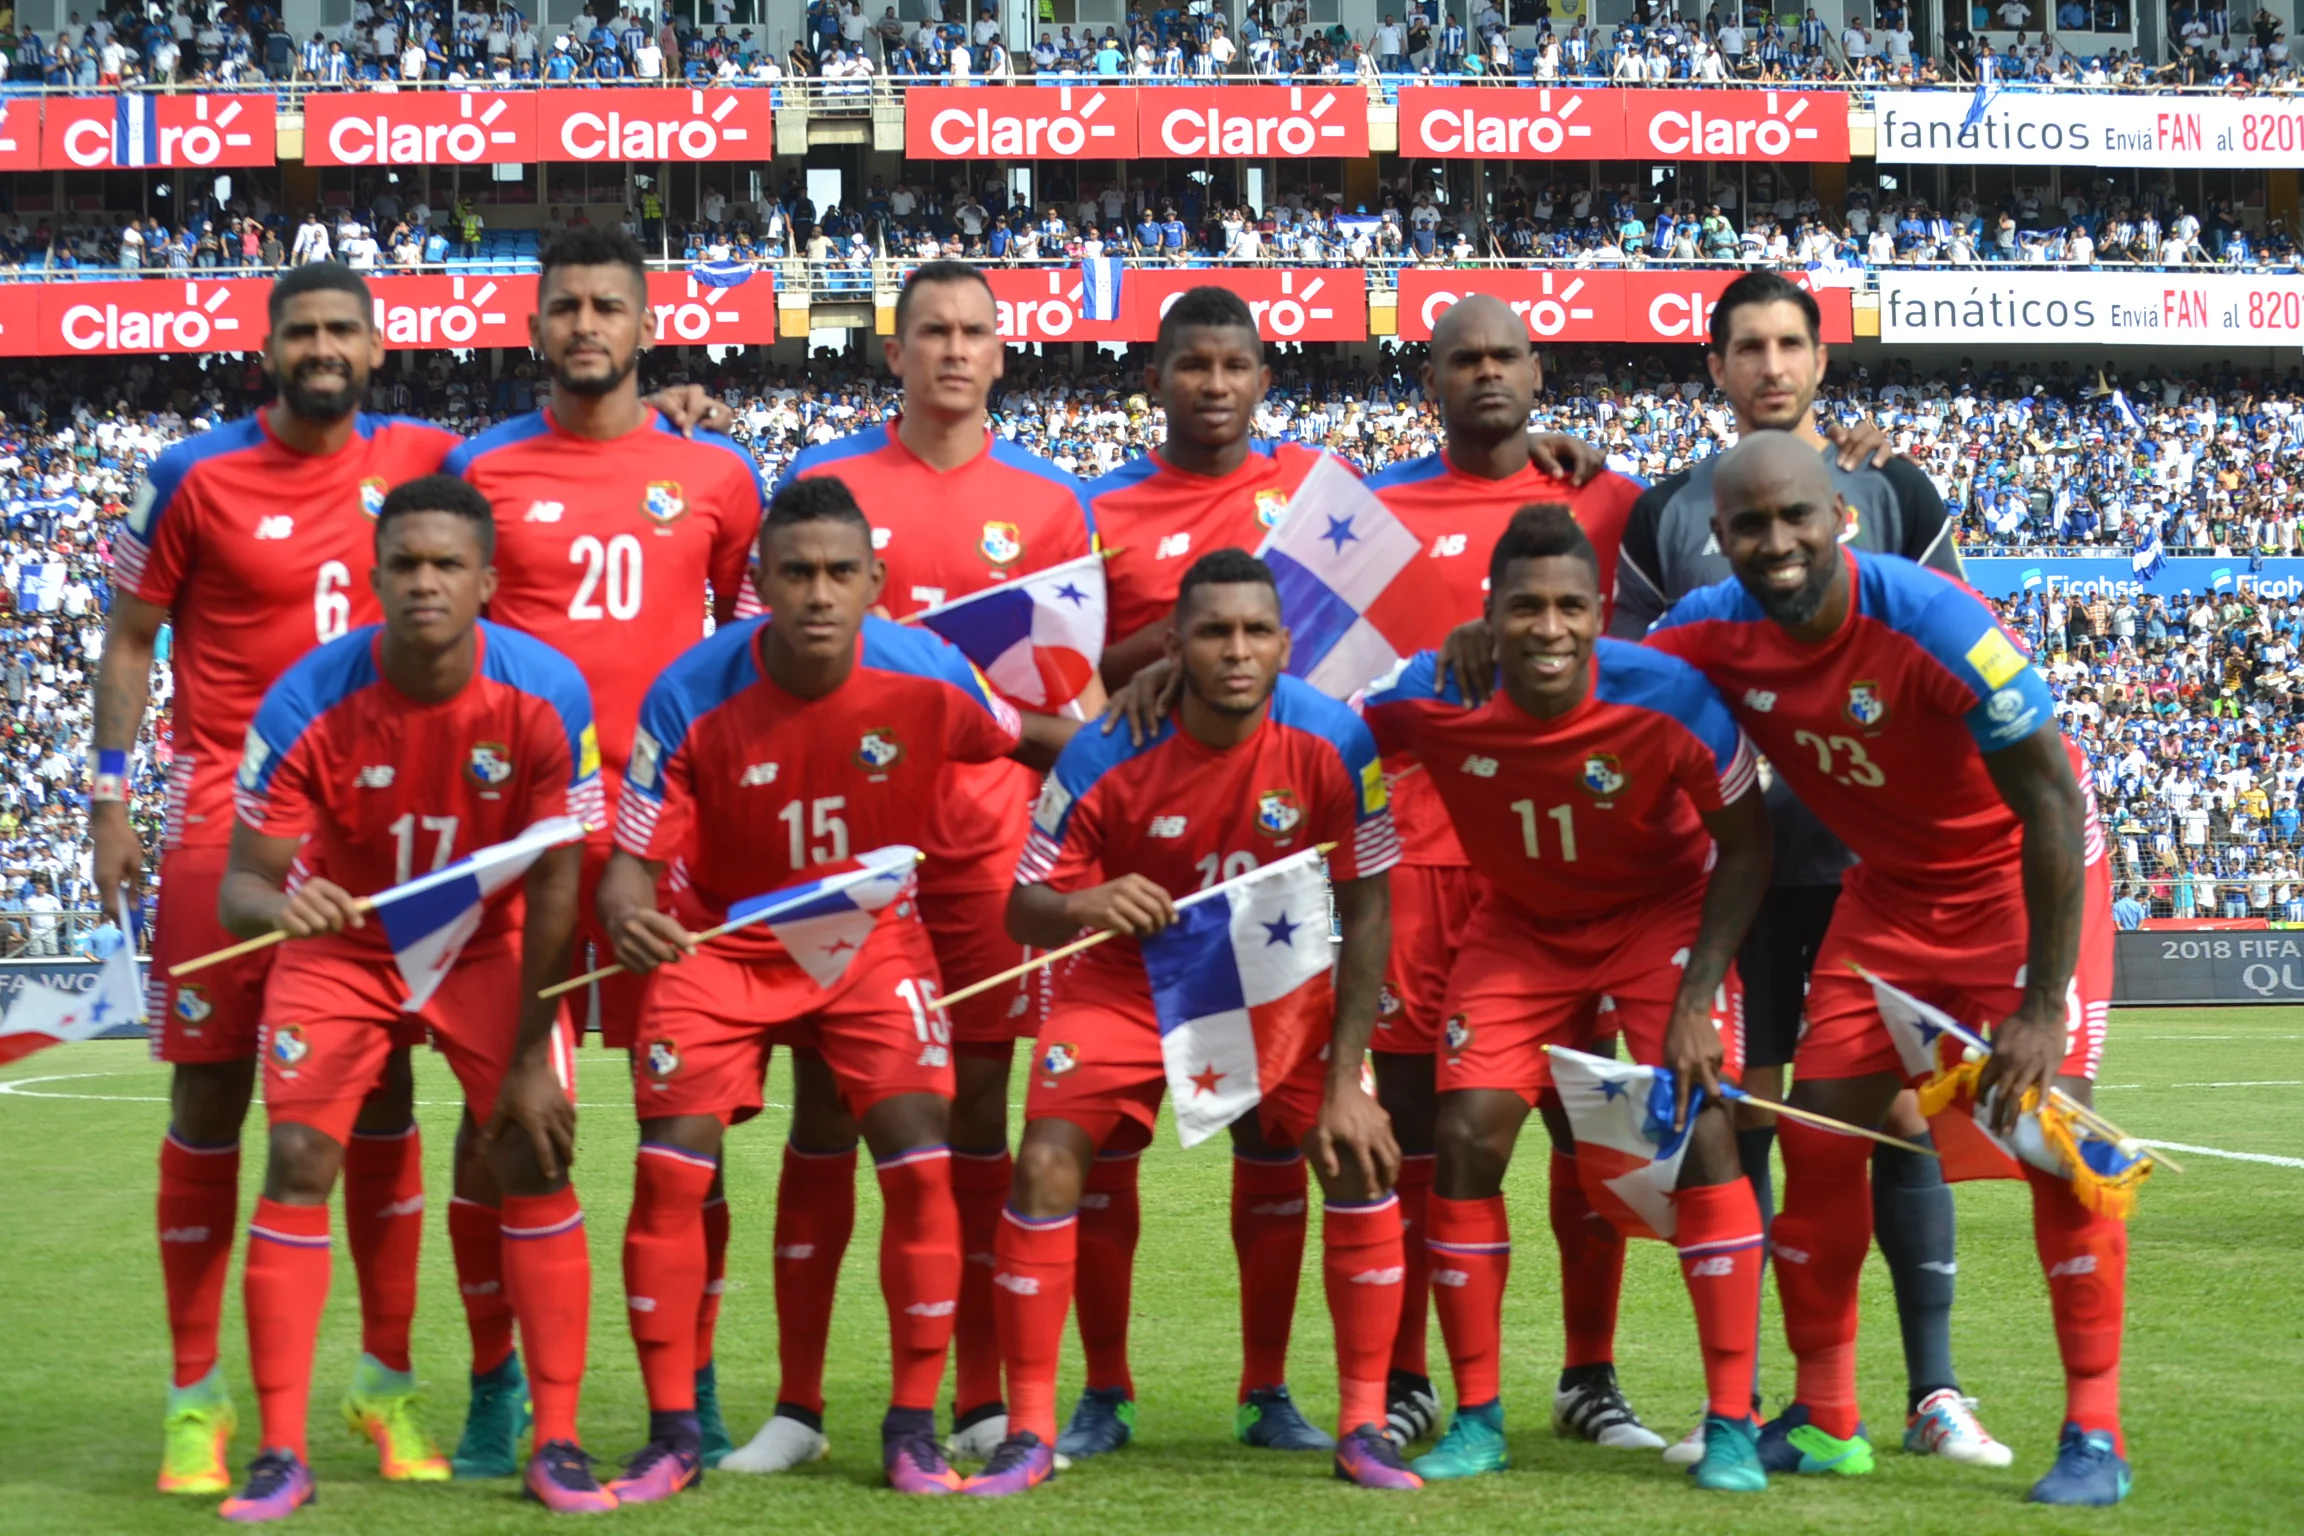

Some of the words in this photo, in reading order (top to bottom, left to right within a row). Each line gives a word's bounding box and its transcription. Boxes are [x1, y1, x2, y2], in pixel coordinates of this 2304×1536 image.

[329, 116, 486, 163] Claro
[561, 112, 717, 160] Claro
[930, 108, 1086, 156] Claro
[1161, 108, 1316, 155] Claro
[1420, 109, 1564, 153] Claro
[1649, 110, 1791, 155] Claro
[2158, 113, 2202, 151] FAN
[2217, 127, 2234, 151] al
[61, 304, 211, 350] Claro
[373, 298, 477, 342] laro
[1888, 287, 2095, 328] fanáticos
[2164, 290, 2208, 328] FAN
[2223, 304, 2240, 329] al
[2248, 291, 2304, 329] 820
[568, 534, 643, 621] 20
[314, 561, 351, 644] 6
[1795, 730, 1886, 788] 23
[389, 813, 460, 886] 17
[779, 796, 849, 870] 15
[1510, 799, 1577, 862] 11
[2161, 940, 2232, 960] 2018
[2239, 940, 2302, 959] FIFA
